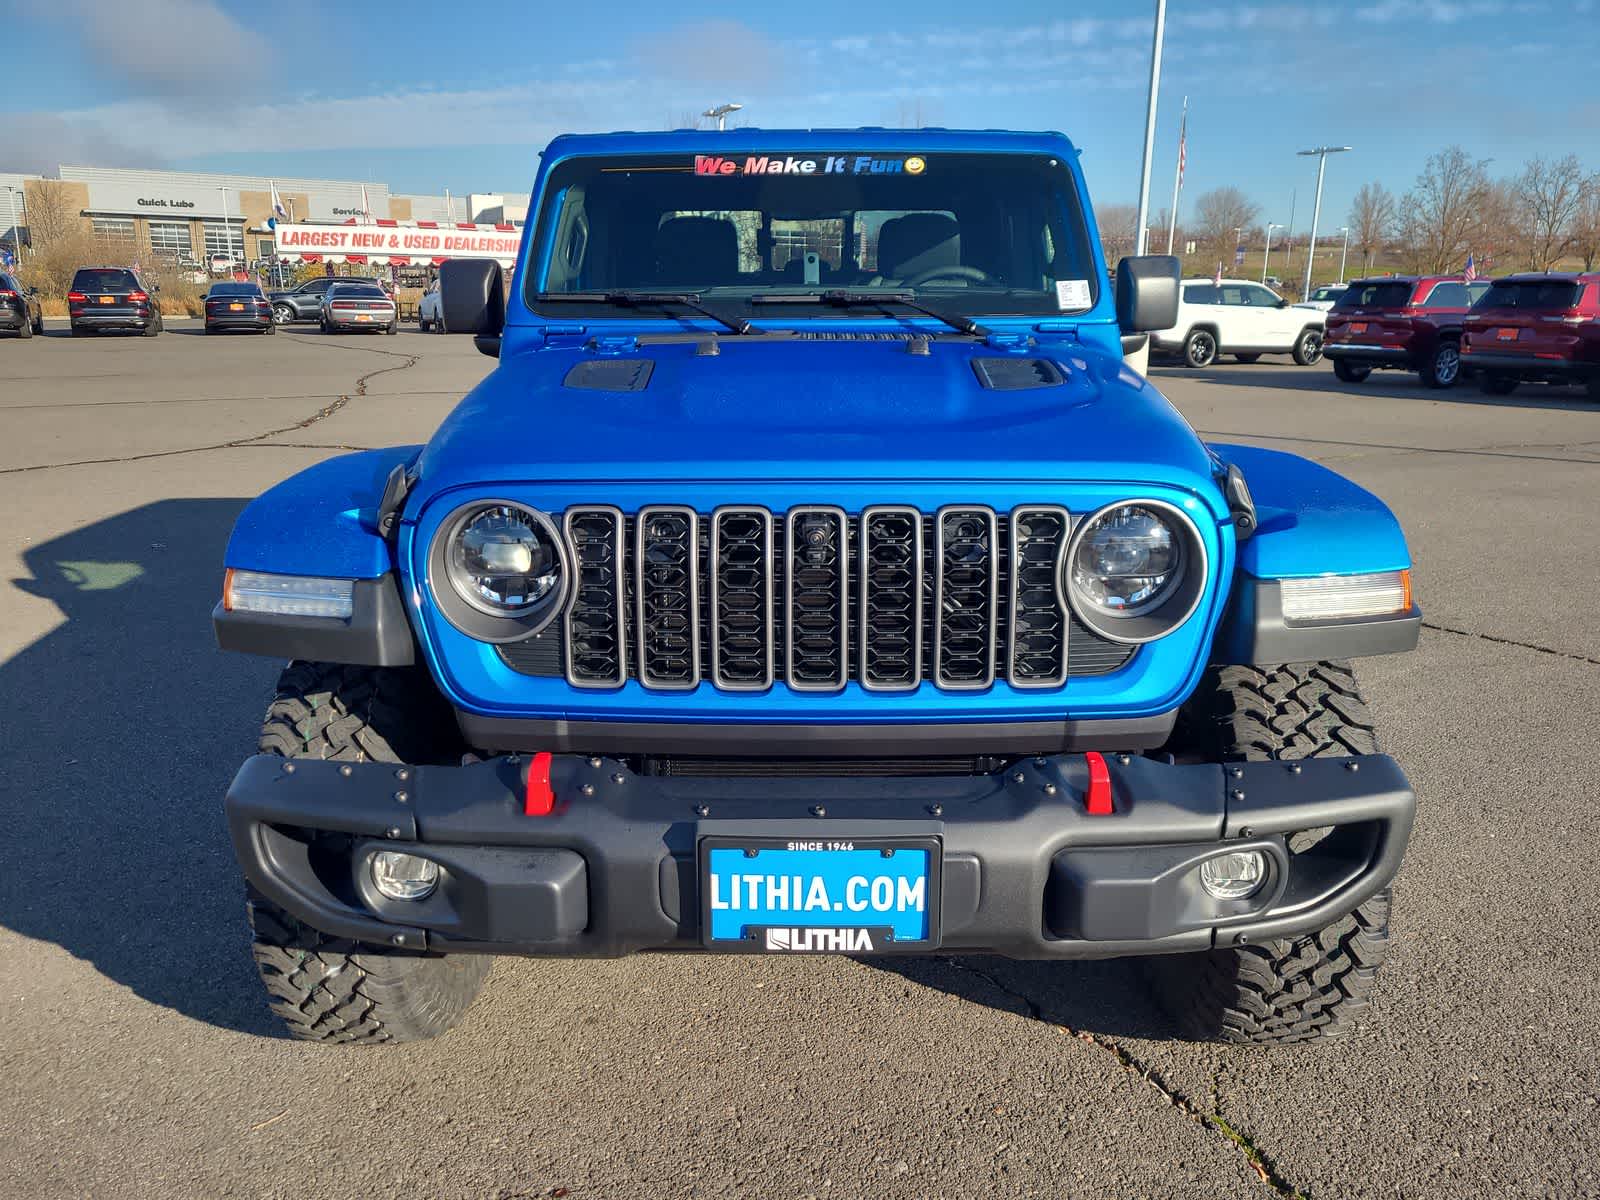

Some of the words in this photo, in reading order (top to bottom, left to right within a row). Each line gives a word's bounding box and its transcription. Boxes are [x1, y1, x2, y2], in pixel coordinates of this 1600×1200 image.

[695, 156, 736, 174] We
[744, 157, 816, 174] Make
[824, 157, 846, 172] It
[854, 157, 902, 173] Fun
[137, 198, 168, 207] Quick
[169, 199, 195, 208] Lube
[281, 231, 348, 246] LARGEST
[351, 233, 385, 247] NEW
[388, 234, 400, 248] &
[403, 235, 440, 249] USED
[444, 236, 520, 252] DEALERSHI
[787, 842, 824, 852] SINCE
[827, 842, 855, 852] 1946
[710, 873, 926, 912] LITHIA.COM
[791, 928, 874, 951] LITHIA
